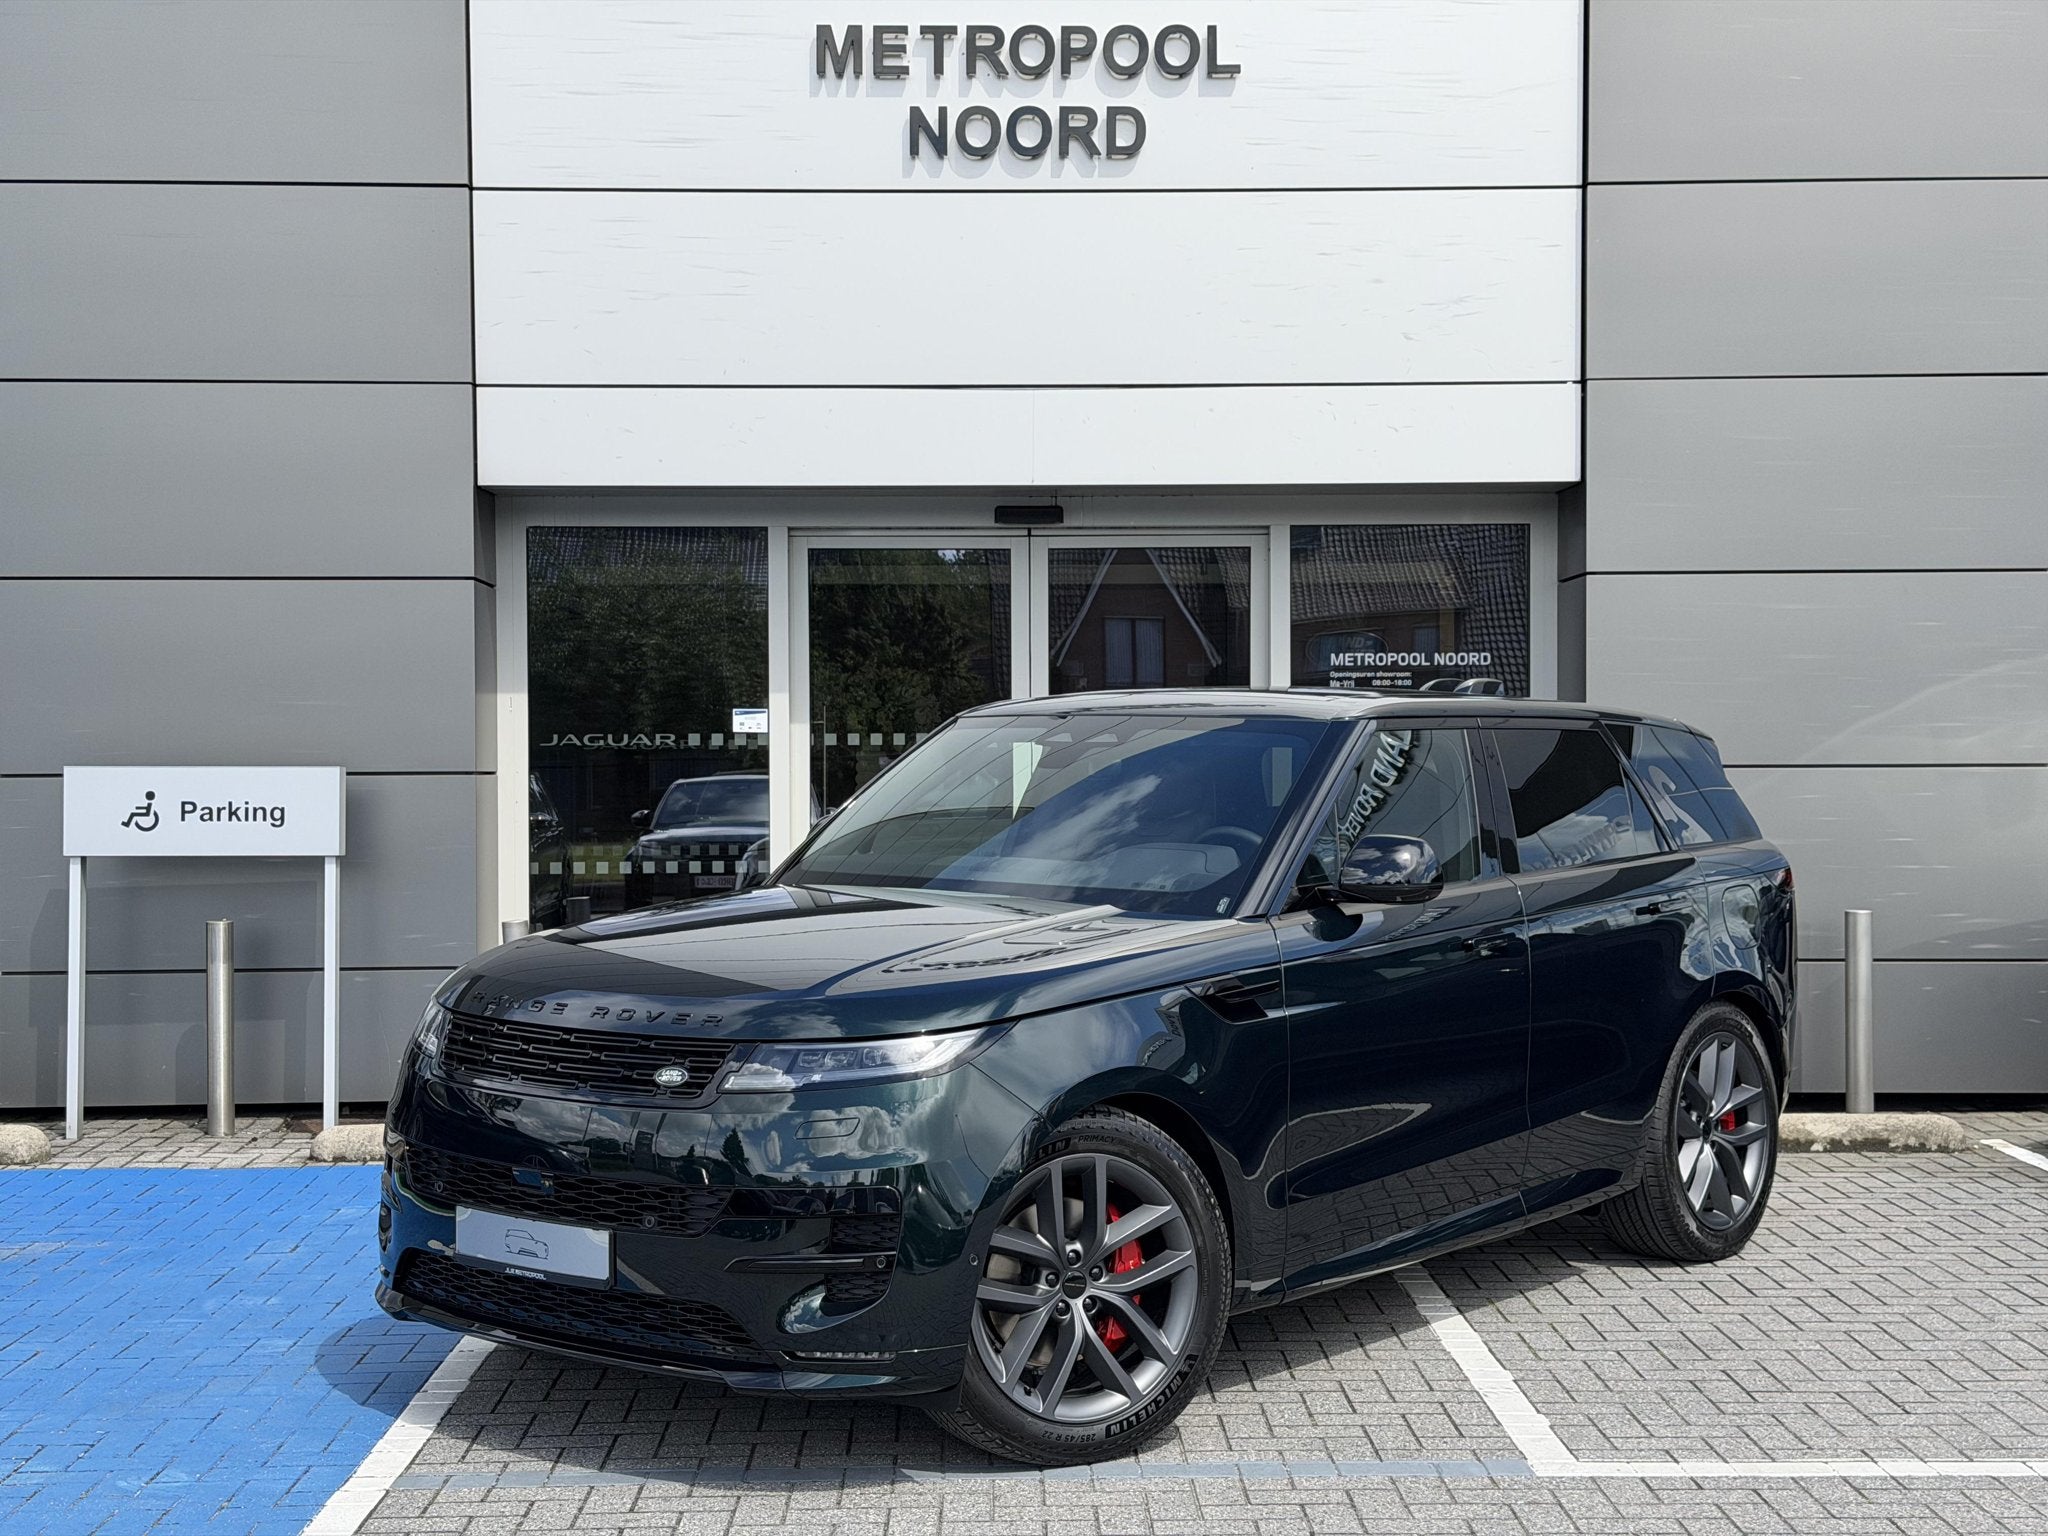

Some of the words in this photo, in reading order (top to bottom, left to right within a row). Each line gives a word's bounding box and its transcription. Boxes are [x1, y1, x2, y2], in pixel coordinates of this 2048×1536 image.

[815, 24, 1241, 77] METROPOOL
[908, 105, 1147, 158] NOORD
[1330, 653, 1430, 666] METROPOOL
[1434, 652, 1491, 666] NOORD
[540, 734, 676, 746] JAGUAR
[180, 801, 286, 828] Parking
[590, 1006, 724, 1027] ROVER
[1110, 1374, 1183, 1436] MICHELIN
